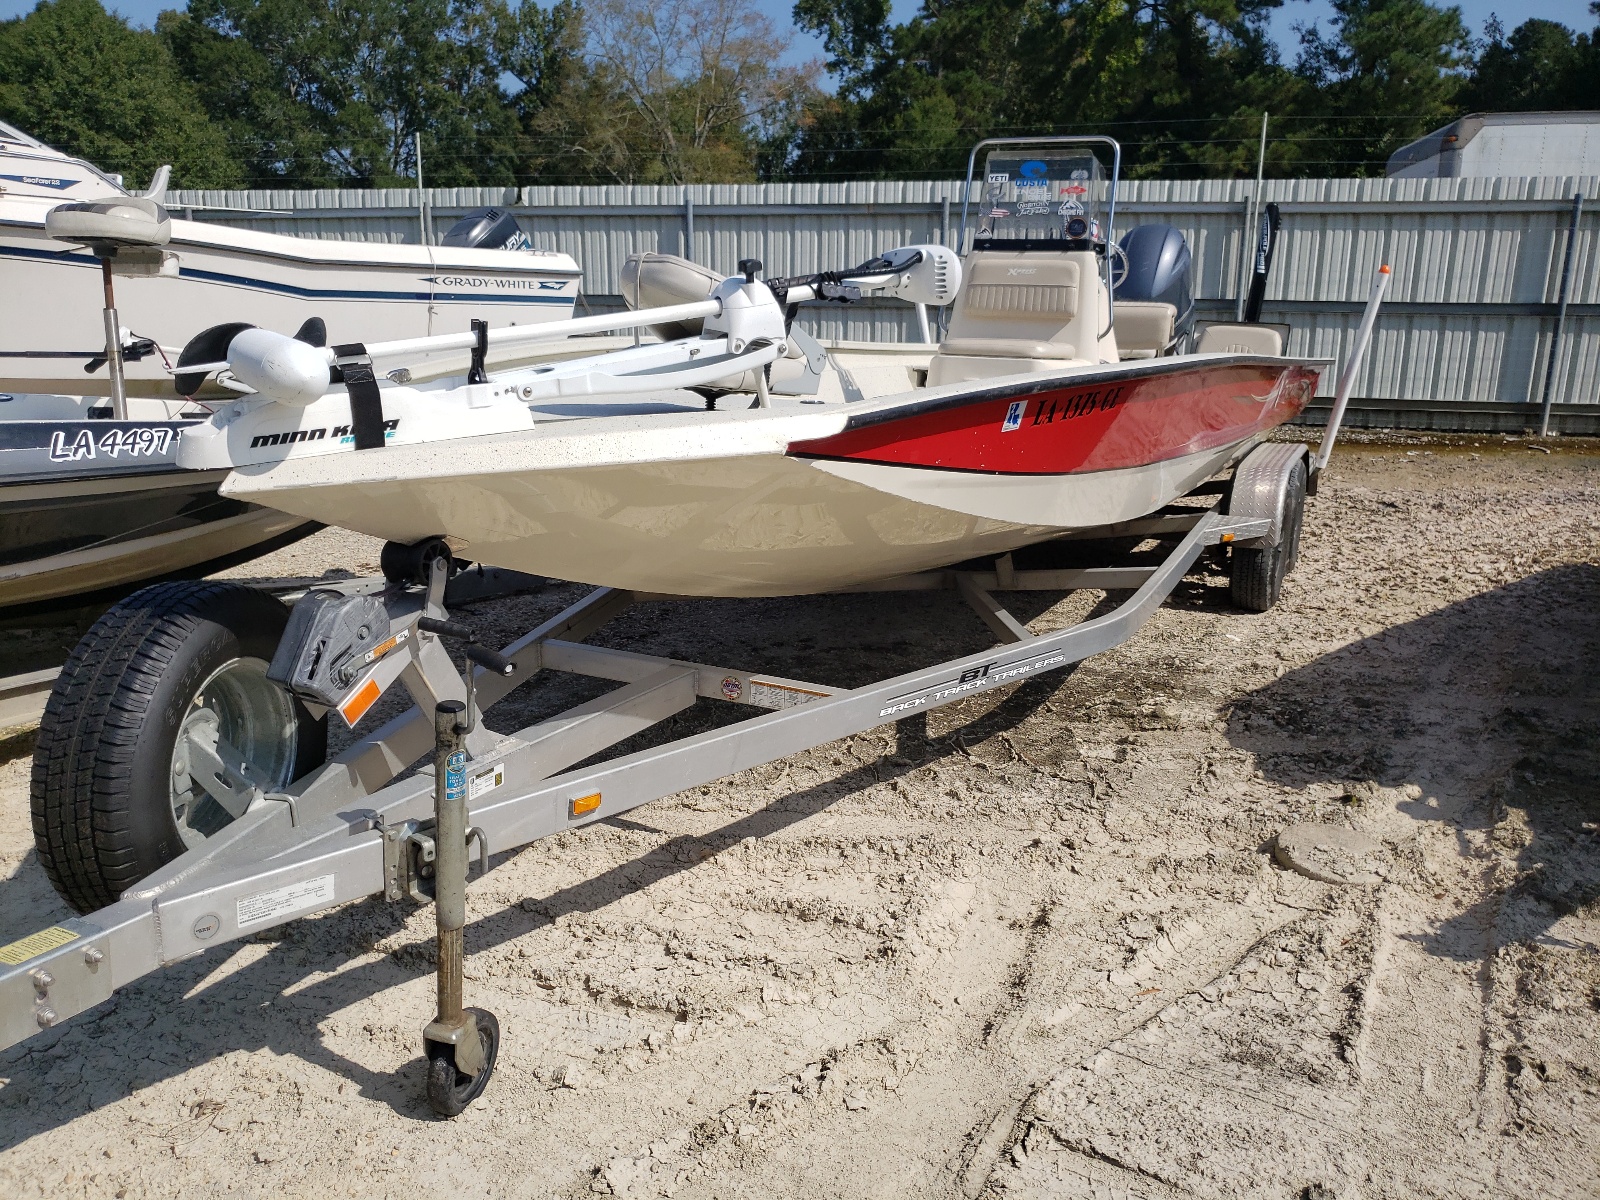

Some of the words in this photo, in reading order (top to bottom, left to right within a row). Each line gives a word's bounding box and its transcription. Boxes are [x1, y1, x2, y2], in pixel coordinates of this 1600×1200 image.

[1015, 178, 1048, 187] COSTA
[443, 277, 535, 290] GRADY-WHITE
[50, 430, 96, 462] LA
[99, 428, 173, 458] 4497
[250, 428, 326, 448] MINN
[331, 419, 400, 438] KA
[879, 694, 929, 717] BACK
[933, 676, 992, 702] TRACK
[993, 654, 1066, 682] TRAILERS
[958, 661, 998, 684] BT
